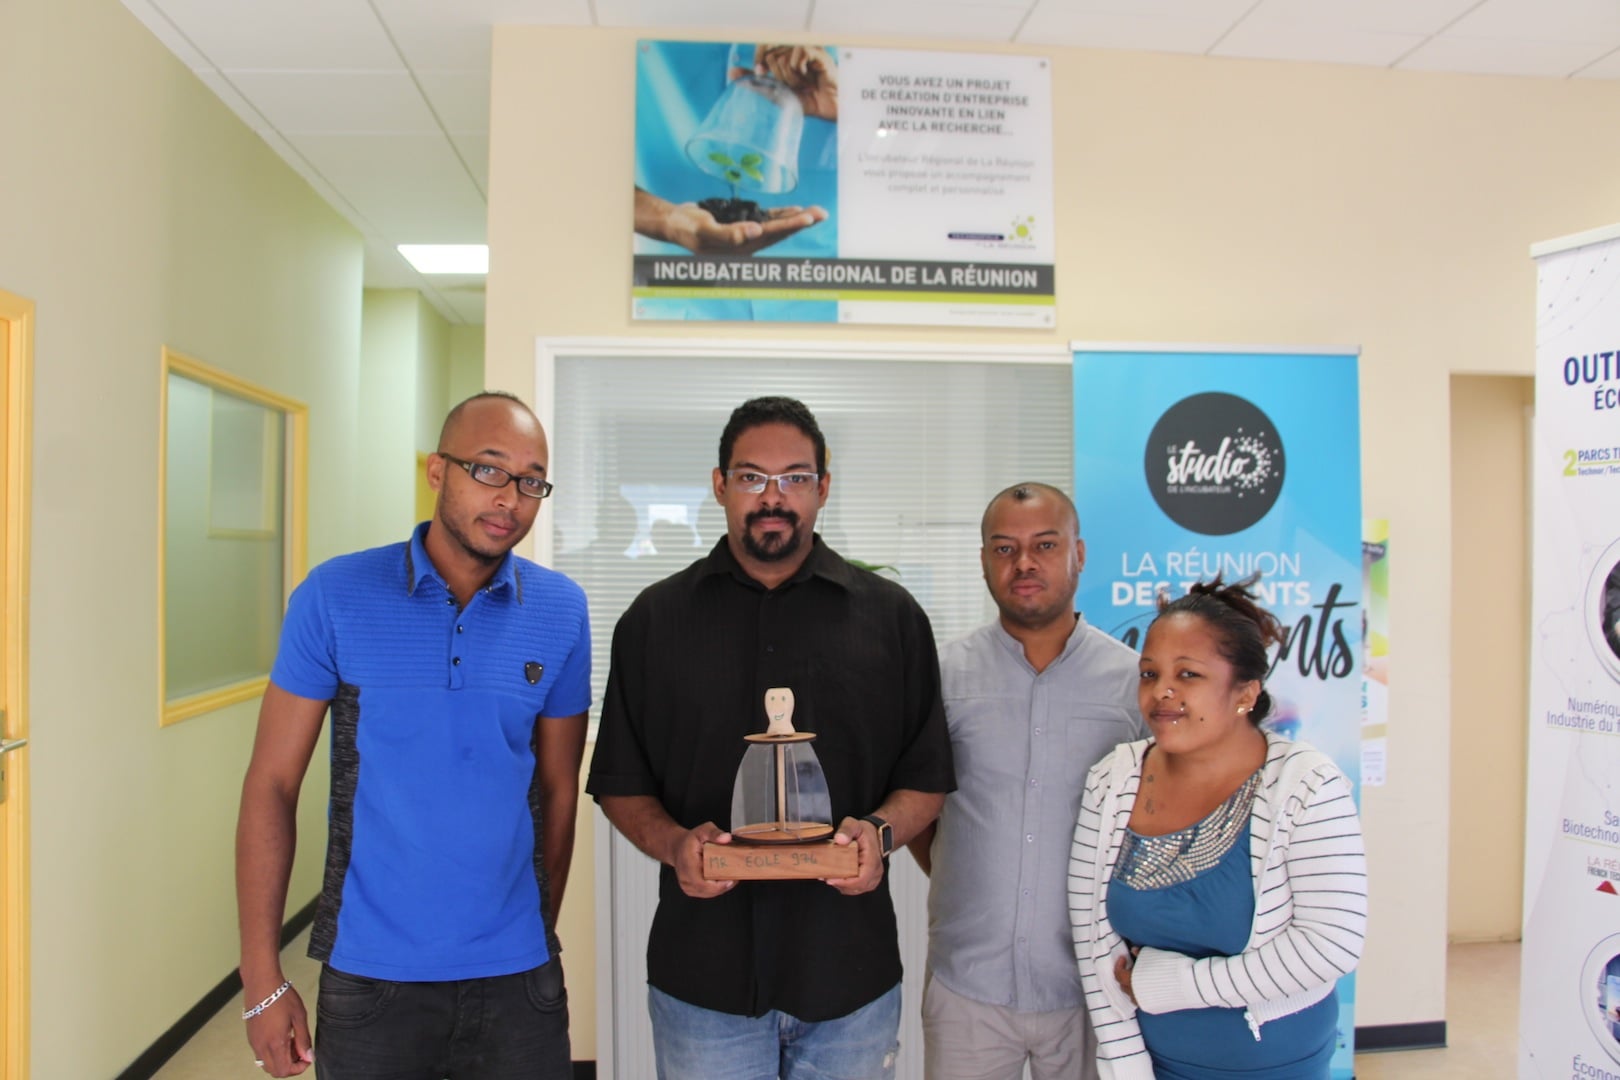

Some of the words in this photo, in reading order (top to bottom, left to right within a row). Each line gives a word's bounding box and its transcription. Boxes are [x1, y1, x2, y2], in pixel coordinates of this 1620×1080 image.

[879, 75, 910, 86] VOUS
[914, 77, 942, 87] AVEZ
[946, 78, 963, 88] UN
[966, 79, 1011, 91] PROJET
[861, 89, 876, 100] DE
[880, 88, 940, 102] CRÉATION
[943, 94, 1029, 107] D'ENTREPRISE
[886, 105, 955, 118] INNOVANTE
[958, 107, 975, 118] EN
[978, 109, 1005, 120] LIEN
[878, 120, 909, 131] AVEC
[912, 121, 927, 131] LA
[967, 155, 978, 166] de
[654, 262, 782, 282] INCUBATEUR
[787, 260, 885, 284] RÉGIONAL
[891, 266, 917, 284] DE
[922, 267, 947, 285] LA
[951, 264, 1038, 288] RÉUNION
[1167, 444, 1177, 454] LE
[1166, 436, 1250, 485] studio
[1563, 449, 1578, 477] 2
[1578, 447, 1611, 461] PARCS
[1122, 552, 1158, 577] LA
[1167, 547, 1299, 577] RÉUNION
[1112, 581, 1171, 606] DES
[1547, 711, 1595, 730] Industrie
[1599, 718, 1613, 732] du
[1587, 855, 1600, 867] LA
